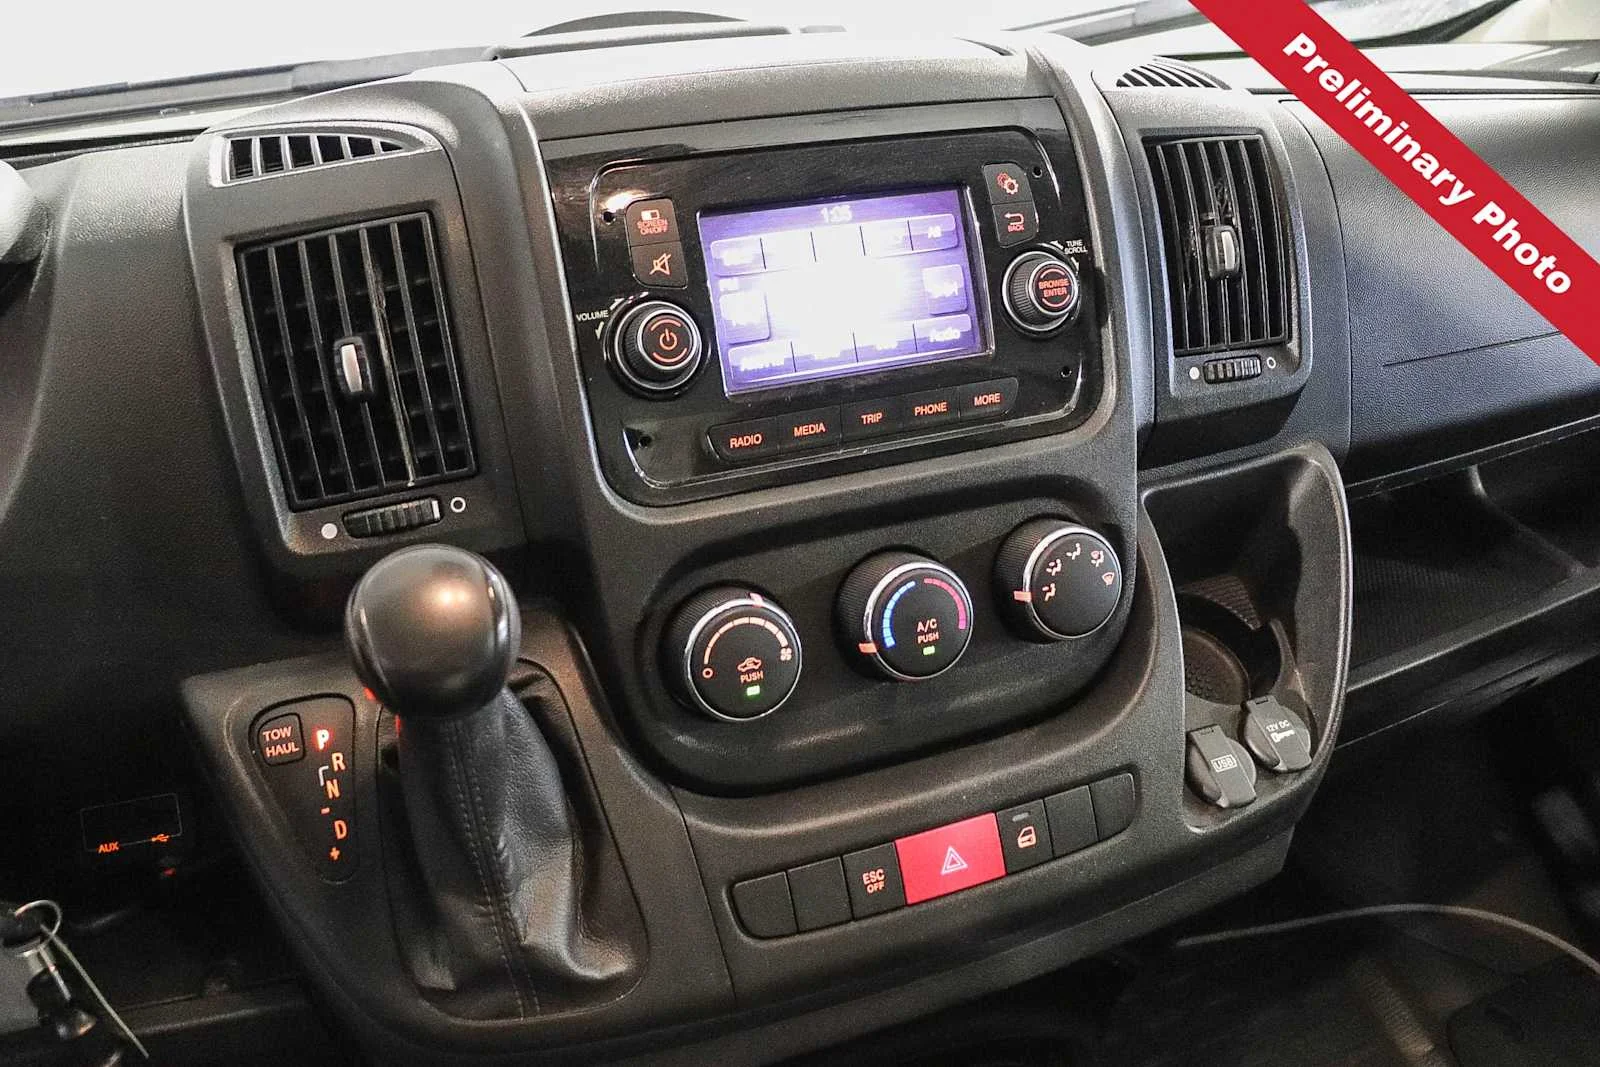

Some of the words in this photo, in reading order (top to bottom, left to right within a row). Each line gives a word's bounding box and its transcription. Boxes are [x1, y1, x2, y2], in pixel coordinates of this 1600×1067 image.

[637, 219, 669, 230] SCREEN
[1007, 224, 1025, 233] BACK
[1064, 245, 1088, 255] SCROLL
[1066, 240, 1083, 248] TUNE
[1039, 278, 1069, 290] BROWSE
[1043, 287, 1067, 297] ENTER
[576, 310, 609, 322] VOLUME
[974, 392, 1001, 407] MORE
[914, 400, 948, 417] PHONE
[861, 411, 883, 425] TRIP
[793, 422, 826, 438] MEDIA
[729, 433, 763, 449] RADIO
[917, 618, 938, 633] A/C
[917, 631, 940, 644] PUSH
[740, 670, 764, 684] PUSH
[1266, 724, 1279, 733] 12V
[1279, 719, 1291, 729] DC
[262, 726, 292, 742] TOW
[316, 729, 330, 750] P
[265, 741, 300, 758] HAUL
[331, 752, 346, 772] R
[1212, 758, 1235, 771] USB
[326, 779, 340, 799] N
[334, 819, 347, 840] D
[98, 841, 119, 853] AUX
[862, 868, 885, 885] ESC
[866, 880, 885, 894] OFF
